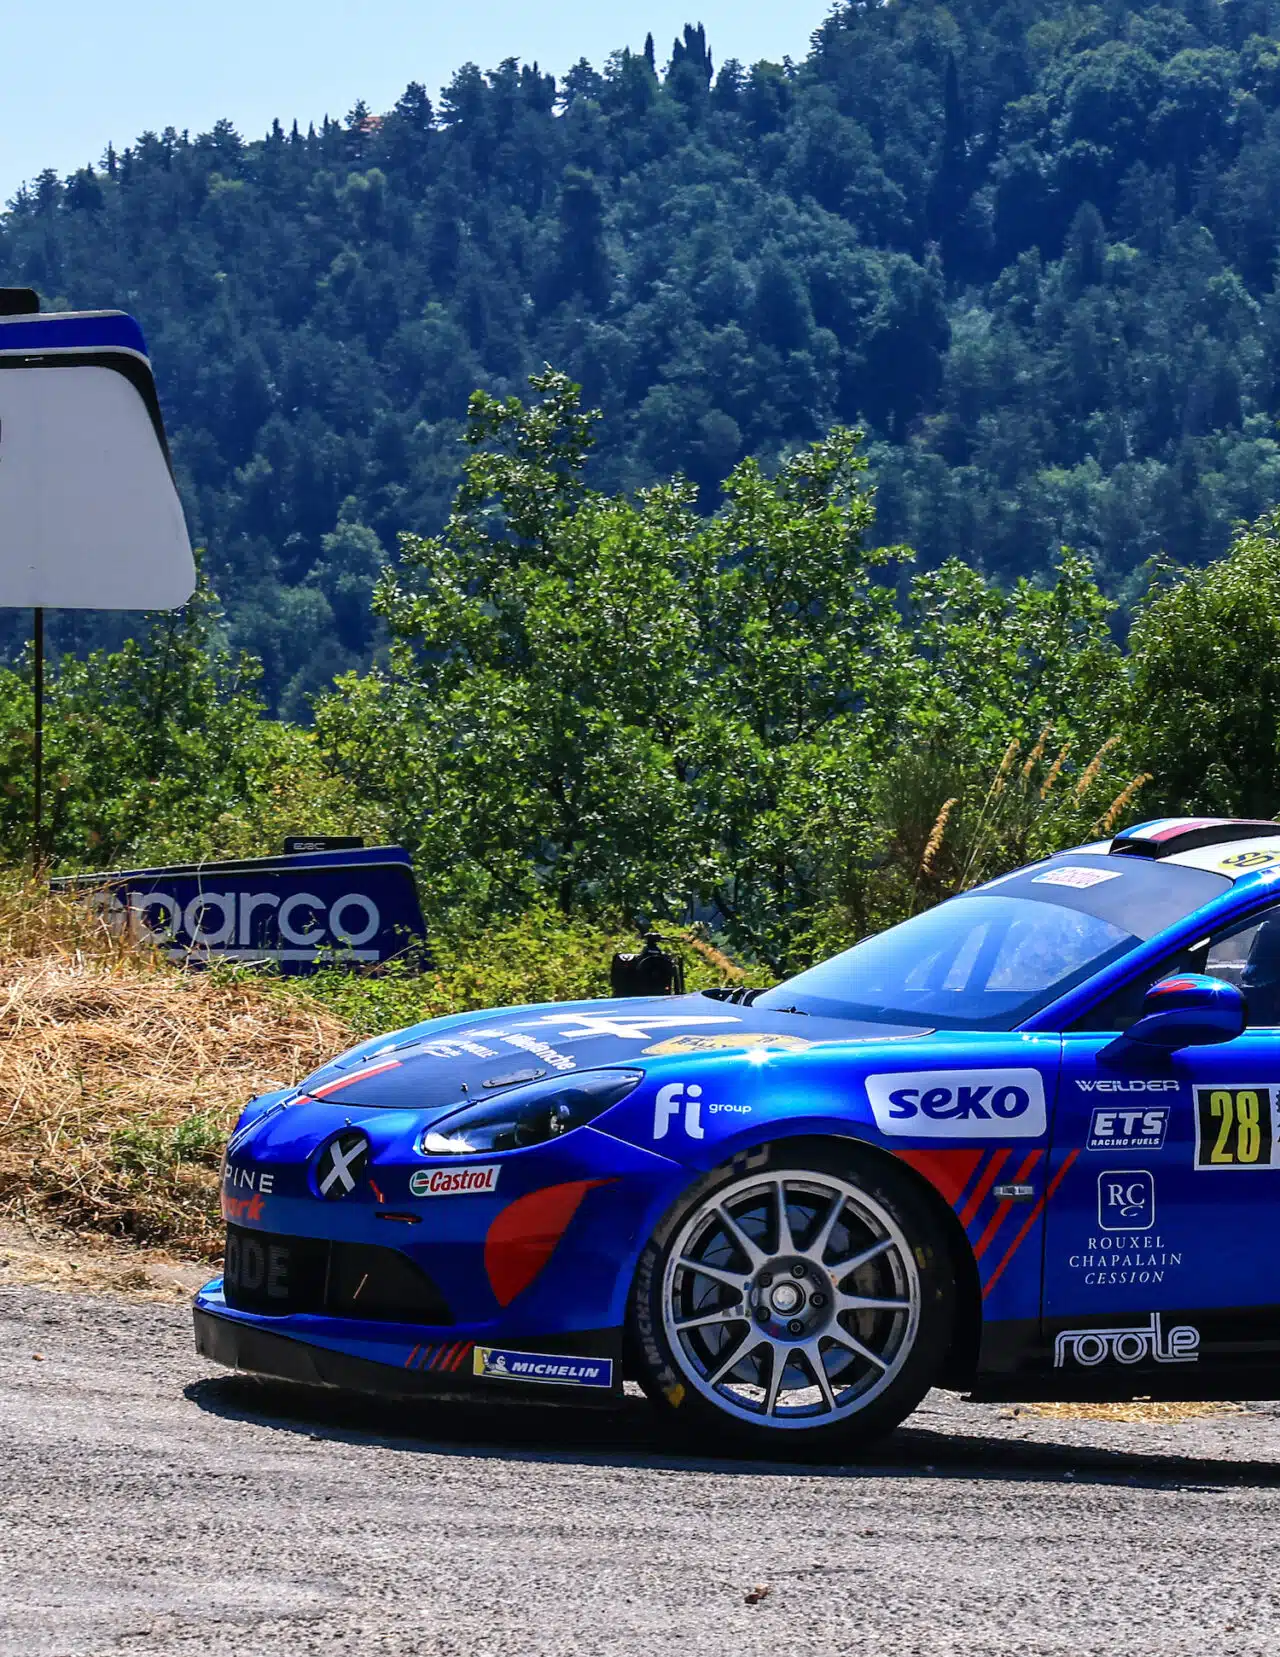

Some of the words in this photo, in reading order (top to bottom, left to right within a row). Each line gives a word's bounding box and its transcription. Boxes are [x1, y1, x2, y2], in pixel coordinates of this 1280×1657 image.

[92, 891, 380, 948] parco
[708, 1101, 752, 1114] group
[1094, 1111, 1164, 1136] ETS
[1210, 1090, 1260, 1164] 28
[1091, 1138, 1129, 1146] RACING
[1131, 1137, 1160, 1146] FUELS
[429, 1168, 493, 1193] Castrol
[1088, 1236, 1165, 1250] ROUXEL
[1069, 1253, 1182, 1268] CHAPALAIN
[1084, 1271, 1165, 1285] CESSION
[511, 1361, 600, 1378] MICHELIN
